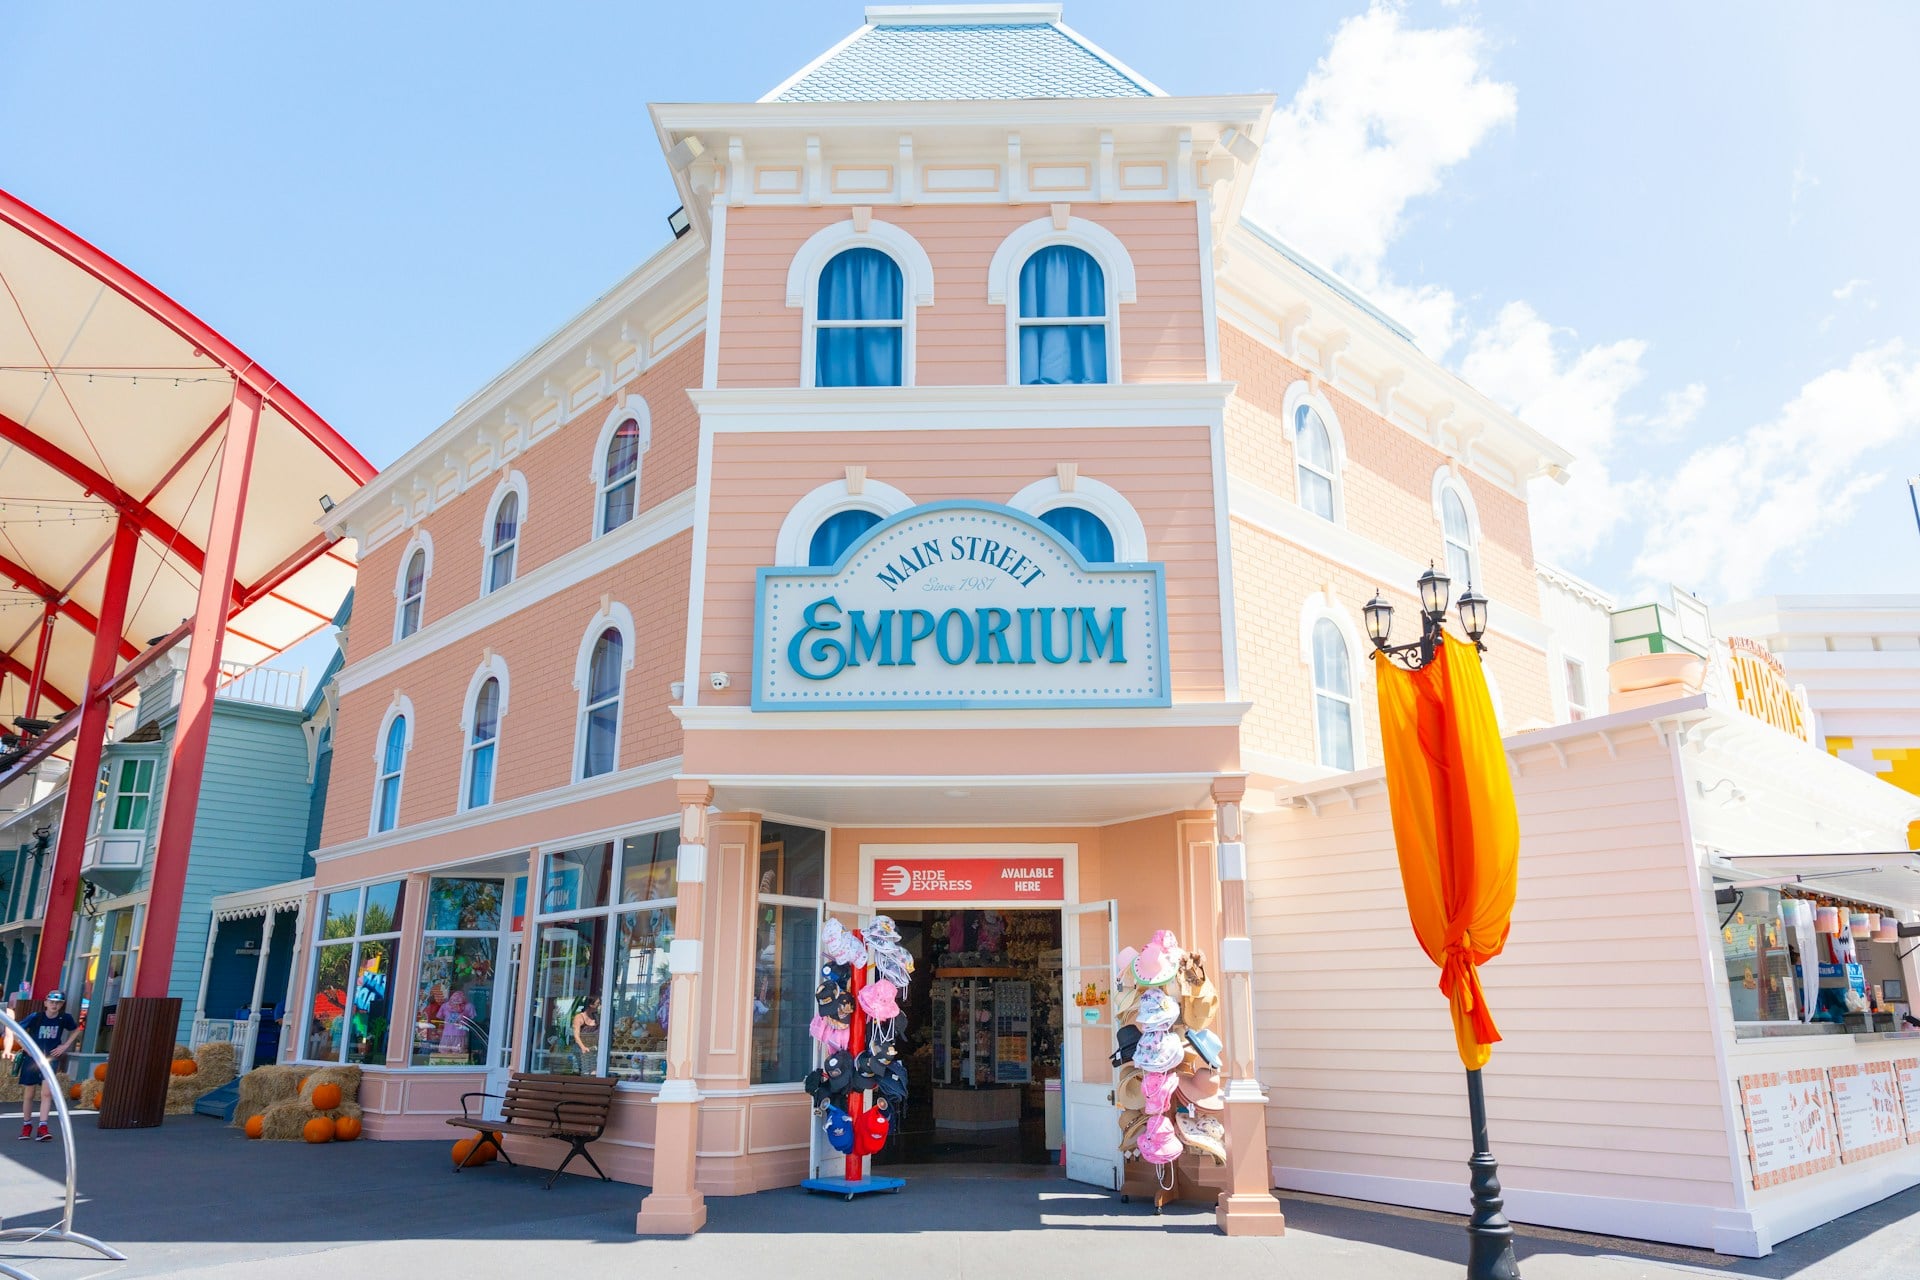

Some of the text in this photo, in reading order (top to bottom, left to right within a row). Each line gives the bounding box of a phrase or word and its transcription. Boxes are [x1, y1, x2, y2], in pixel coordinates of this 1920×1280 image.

[875, 535, 1046, 592] MAIN STREET
[921, 575, 997, 592] Since 1981
[787, 595, 1128, 681] EMPORIUM
[912, 869, 946, 880] RIDE
[1001, 867, 1054, 879] AVAILABLE
[912, 879, 973, 891] EXPRESS
[1014, 880, 1041, 892] HERE
